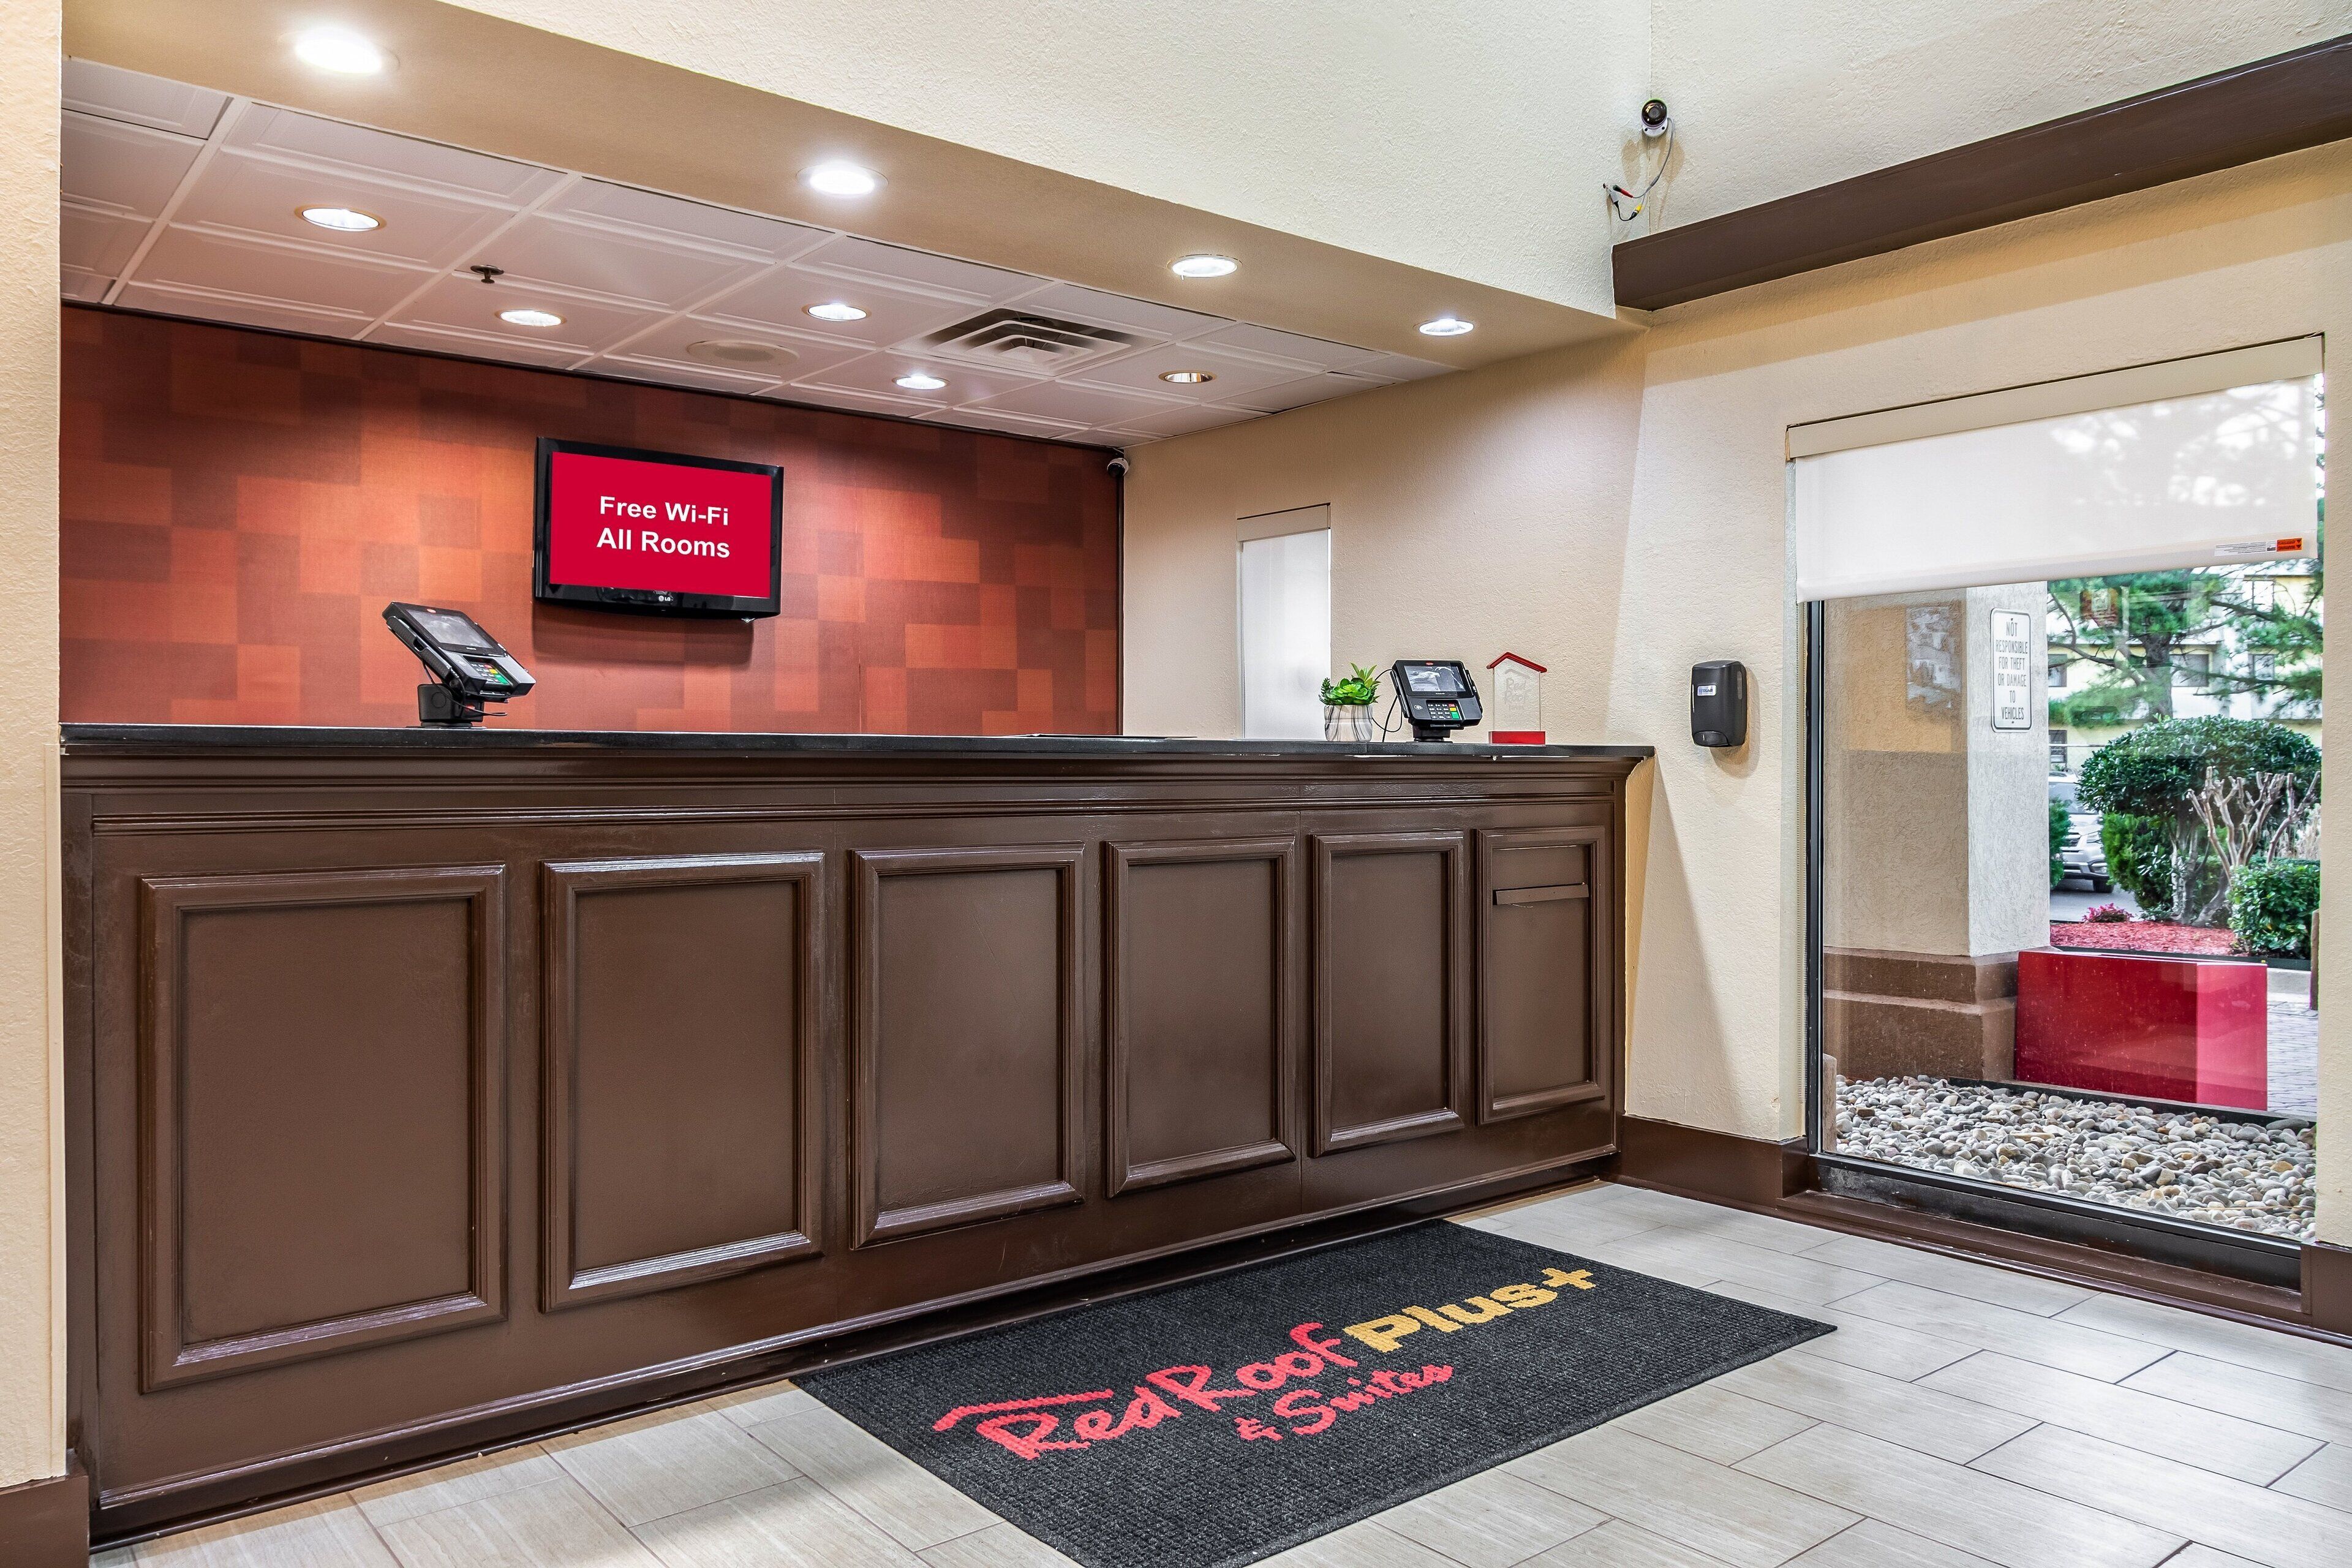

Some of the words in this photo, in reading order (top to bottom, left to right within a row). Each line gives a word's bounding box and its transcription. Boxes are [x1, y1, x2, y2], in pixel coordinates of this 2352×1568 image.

[600, 496, 657, 519] Free
[665, 502, 729, 526] Wi-Fi
[596, 527, 631, 550] All
[641, 530, 730, 558] Rooms
[2005, 622, 2018, 637] NOT
[1995, 639, 2028, 654] RESPONSIBLE
[1999, 657, 2008, 670] FOR
[2010, 657, 2026, 670] THEFT
[1506, 677, 1527, 692] Red
[1997, 673, 2005, 686] OR
[2007, 674, 2027, 687] DAMAGE
[2009, 690, 2016, 703] TO
[2001, 707, 2024, 720] VEHICLES
[1235, 1417, 1284, 1441] &
[1273, 1363, 1454, 1436] Suites
